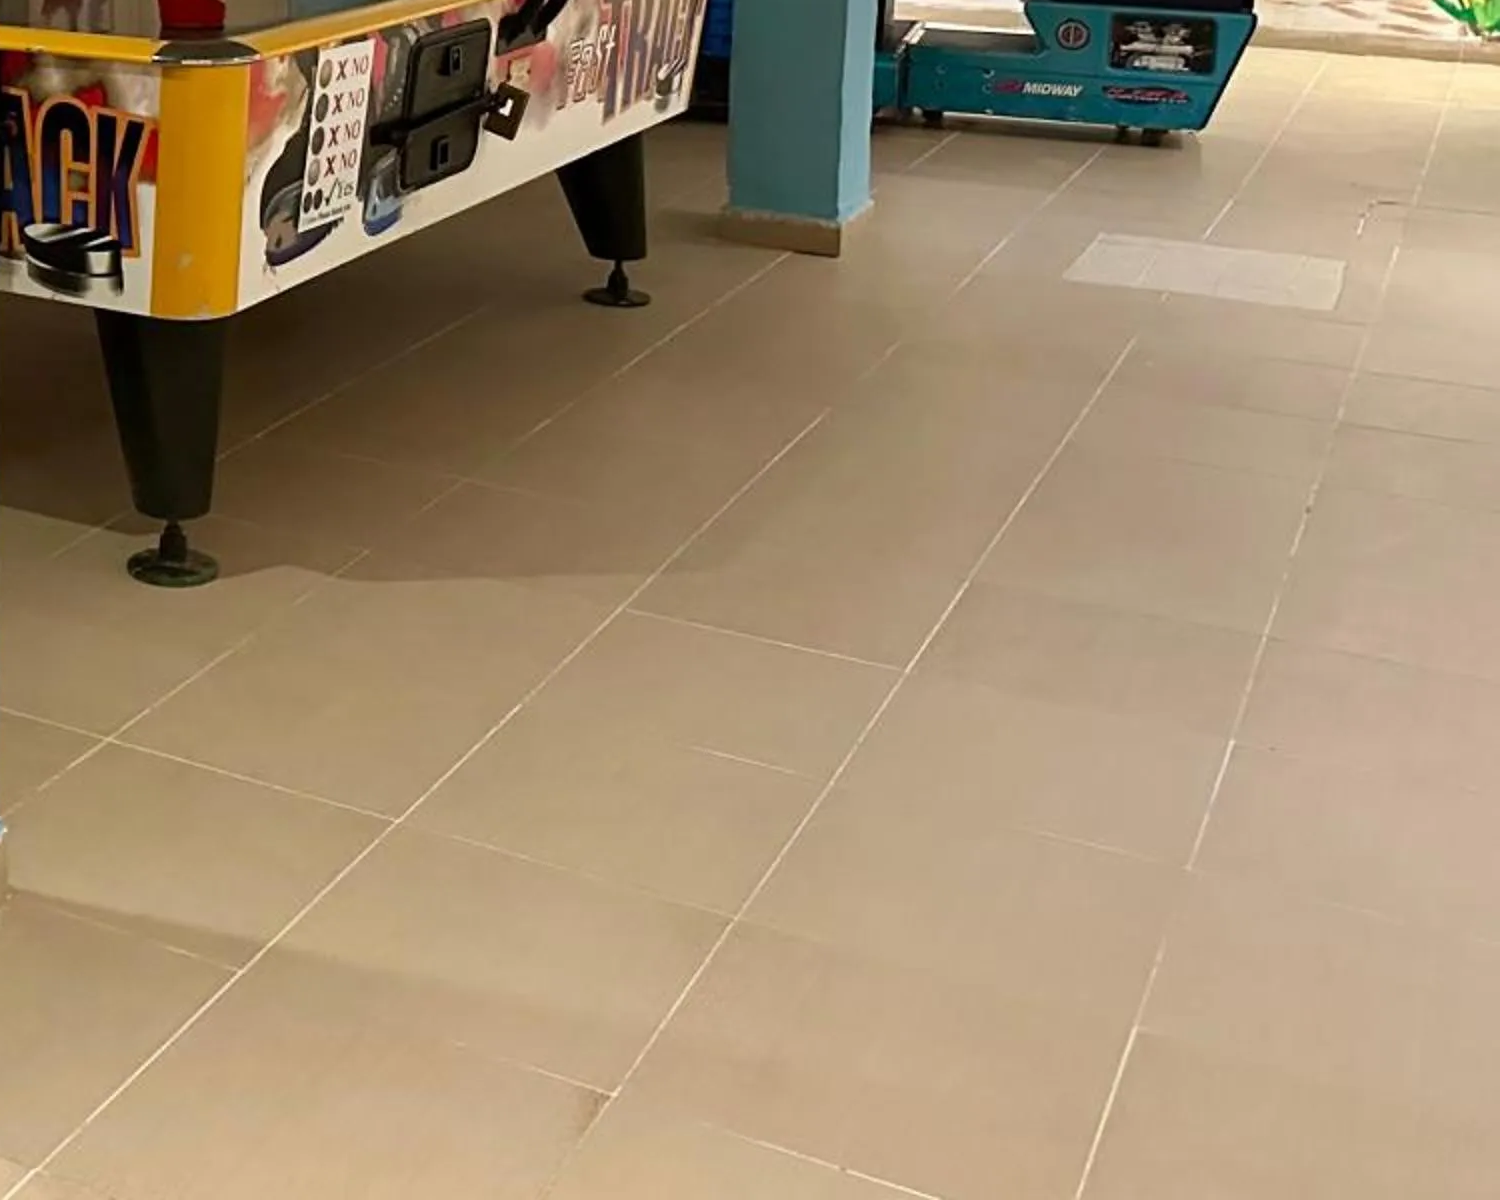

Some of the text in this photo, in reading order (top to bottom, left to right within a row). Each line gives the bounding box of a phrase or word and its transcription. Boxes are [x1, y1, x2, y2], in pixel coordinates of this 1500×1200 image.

[351, 54, 369, 78] NO
[346, 87, 365, 110] NO
[1021, 81, 1084, 98] MIDWAY
[343, 119, 361, 143] NO
[339, 148, 358, 172] NO
